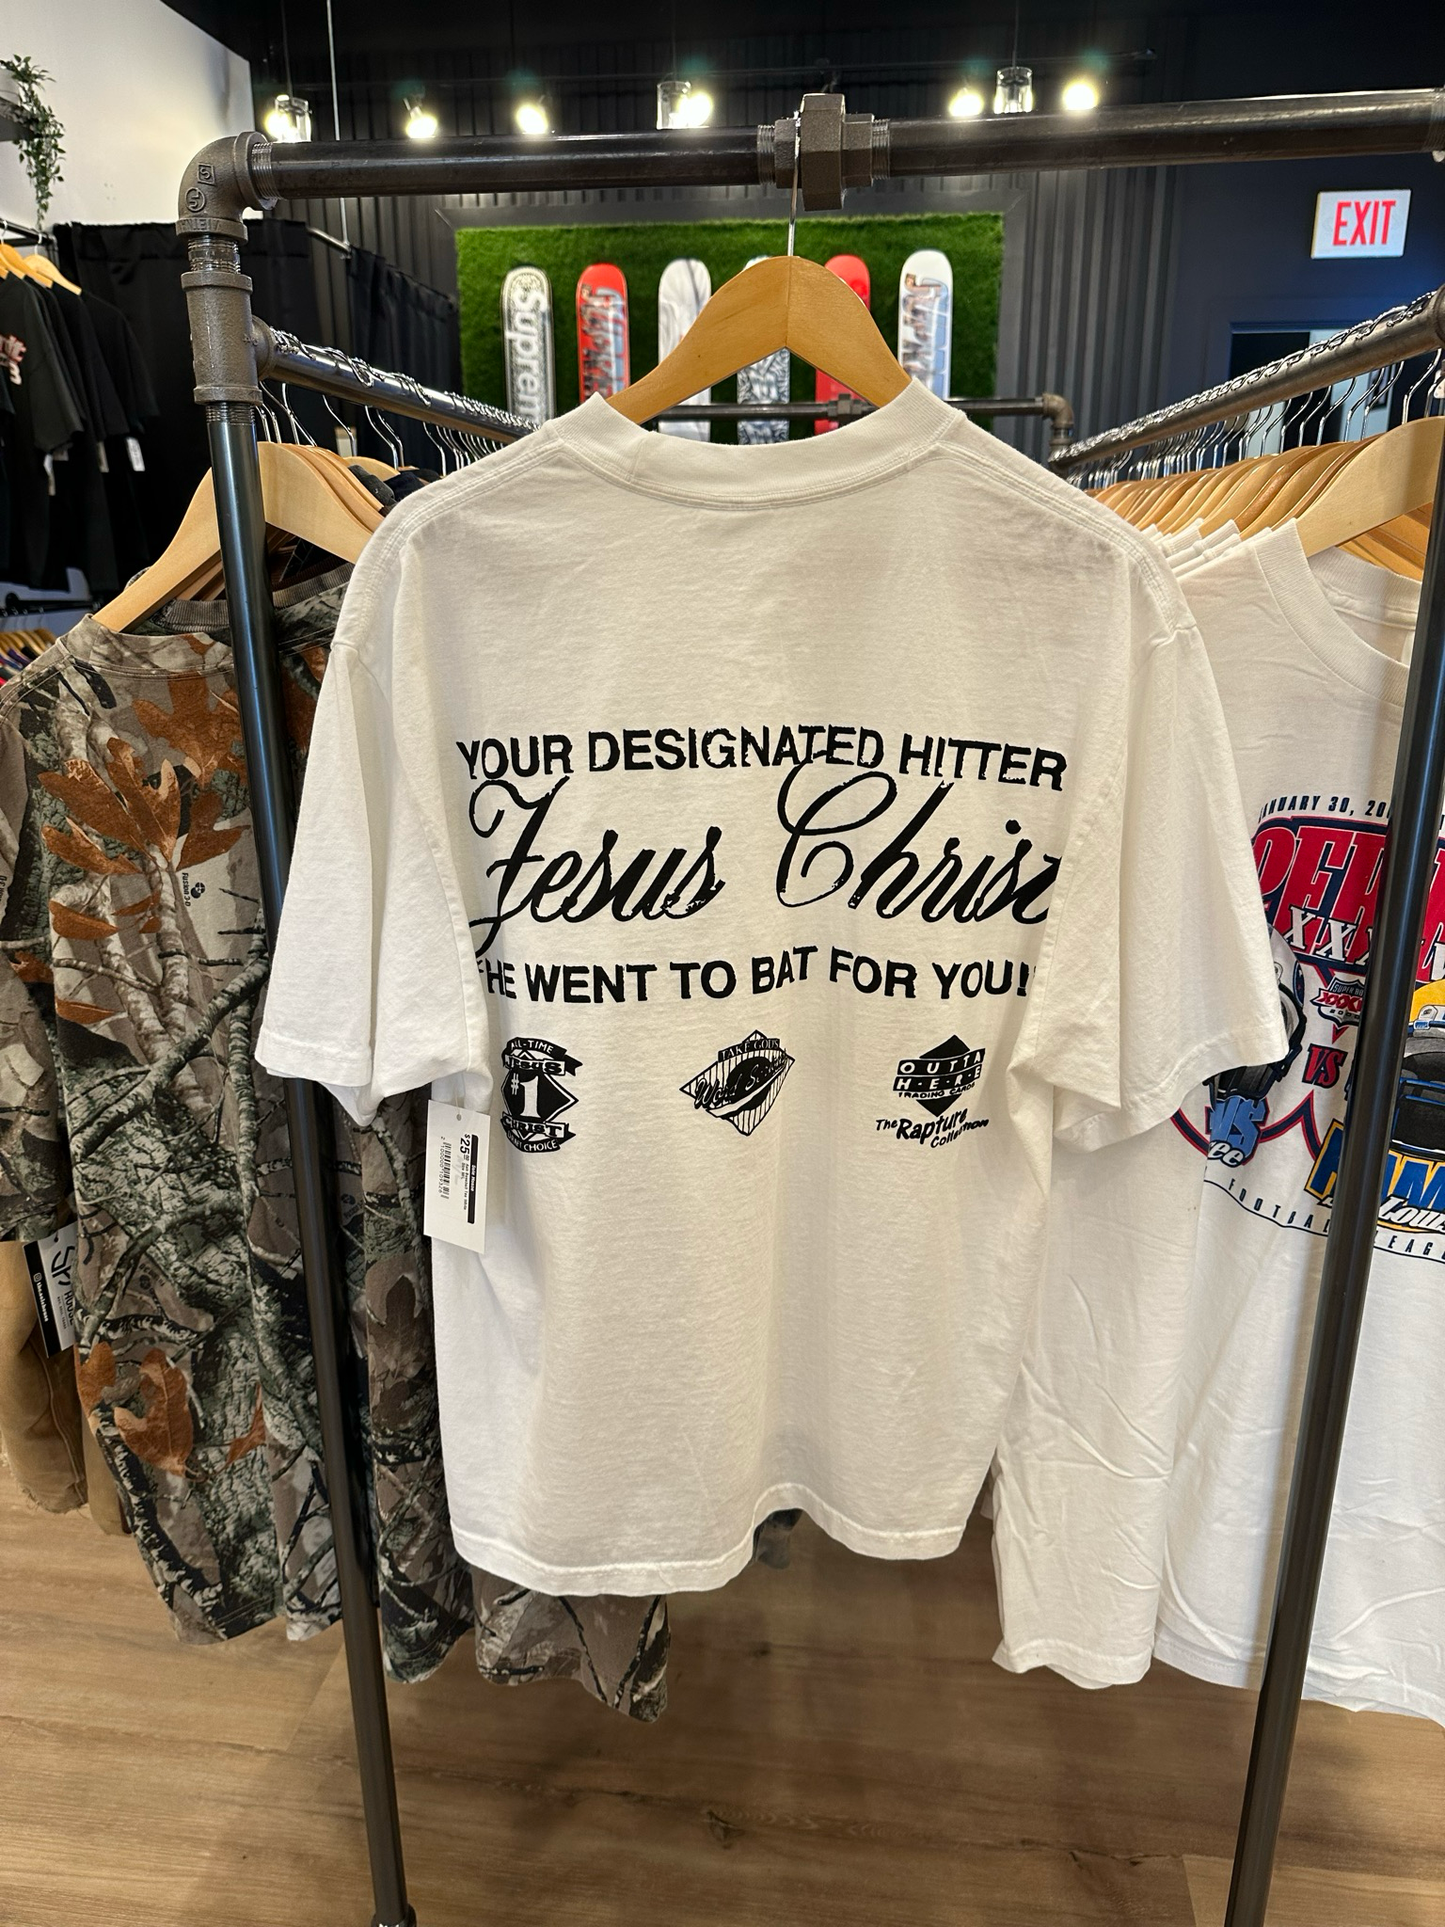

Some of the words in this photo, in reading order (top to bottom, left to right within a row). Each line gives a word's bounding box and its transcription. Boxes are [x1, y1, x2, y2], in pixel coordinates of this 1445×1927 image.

[1332, 200, 1396, 246] EXIT
[504, 287, 548, 423] Suprem
[456, 734, 574, 780] YOUR
[588, 724, 885, 772] DESIGNATED
[899, 733, 1068, 791] HITTER
[1258, 795, 1321, 824] ANUARY
[1328, 796, 1354, 816] 30,
[1365, 800, 1391, 819] 20
[468, 775, 726, 959] Jesus
[524, 962, 658, 1004] WENT
[669, 960, 737, 999] TO
[751, 946, 818, 995] BAT
[829, 946, 917, 999] FOR
[932, 959, 1037, 1000] YOU!
[1332, 983, 1355, 994] SUPER
[1354, 988, 1364, 997] BO
[510, 1039, 554, 1054] ALL-TIME
[721, 1042, 752, 1060] TAKE
[899, 1051, 981, 1074] OUTTA
[1305, 1046, 1346, 1088] VS
[898, 1090, 945, 1099] TRADING
[949, 1082, 975, 1094] CARDS
[876, 1119, 898, 1131] The
[896, 1108, 968, 1145] Rapture
[930, 1119, 989, 1148] Collection
[523, 1139, 558, 1151] CHOICE
[1228, 1178, 1331, 1233] FOOTBAL
